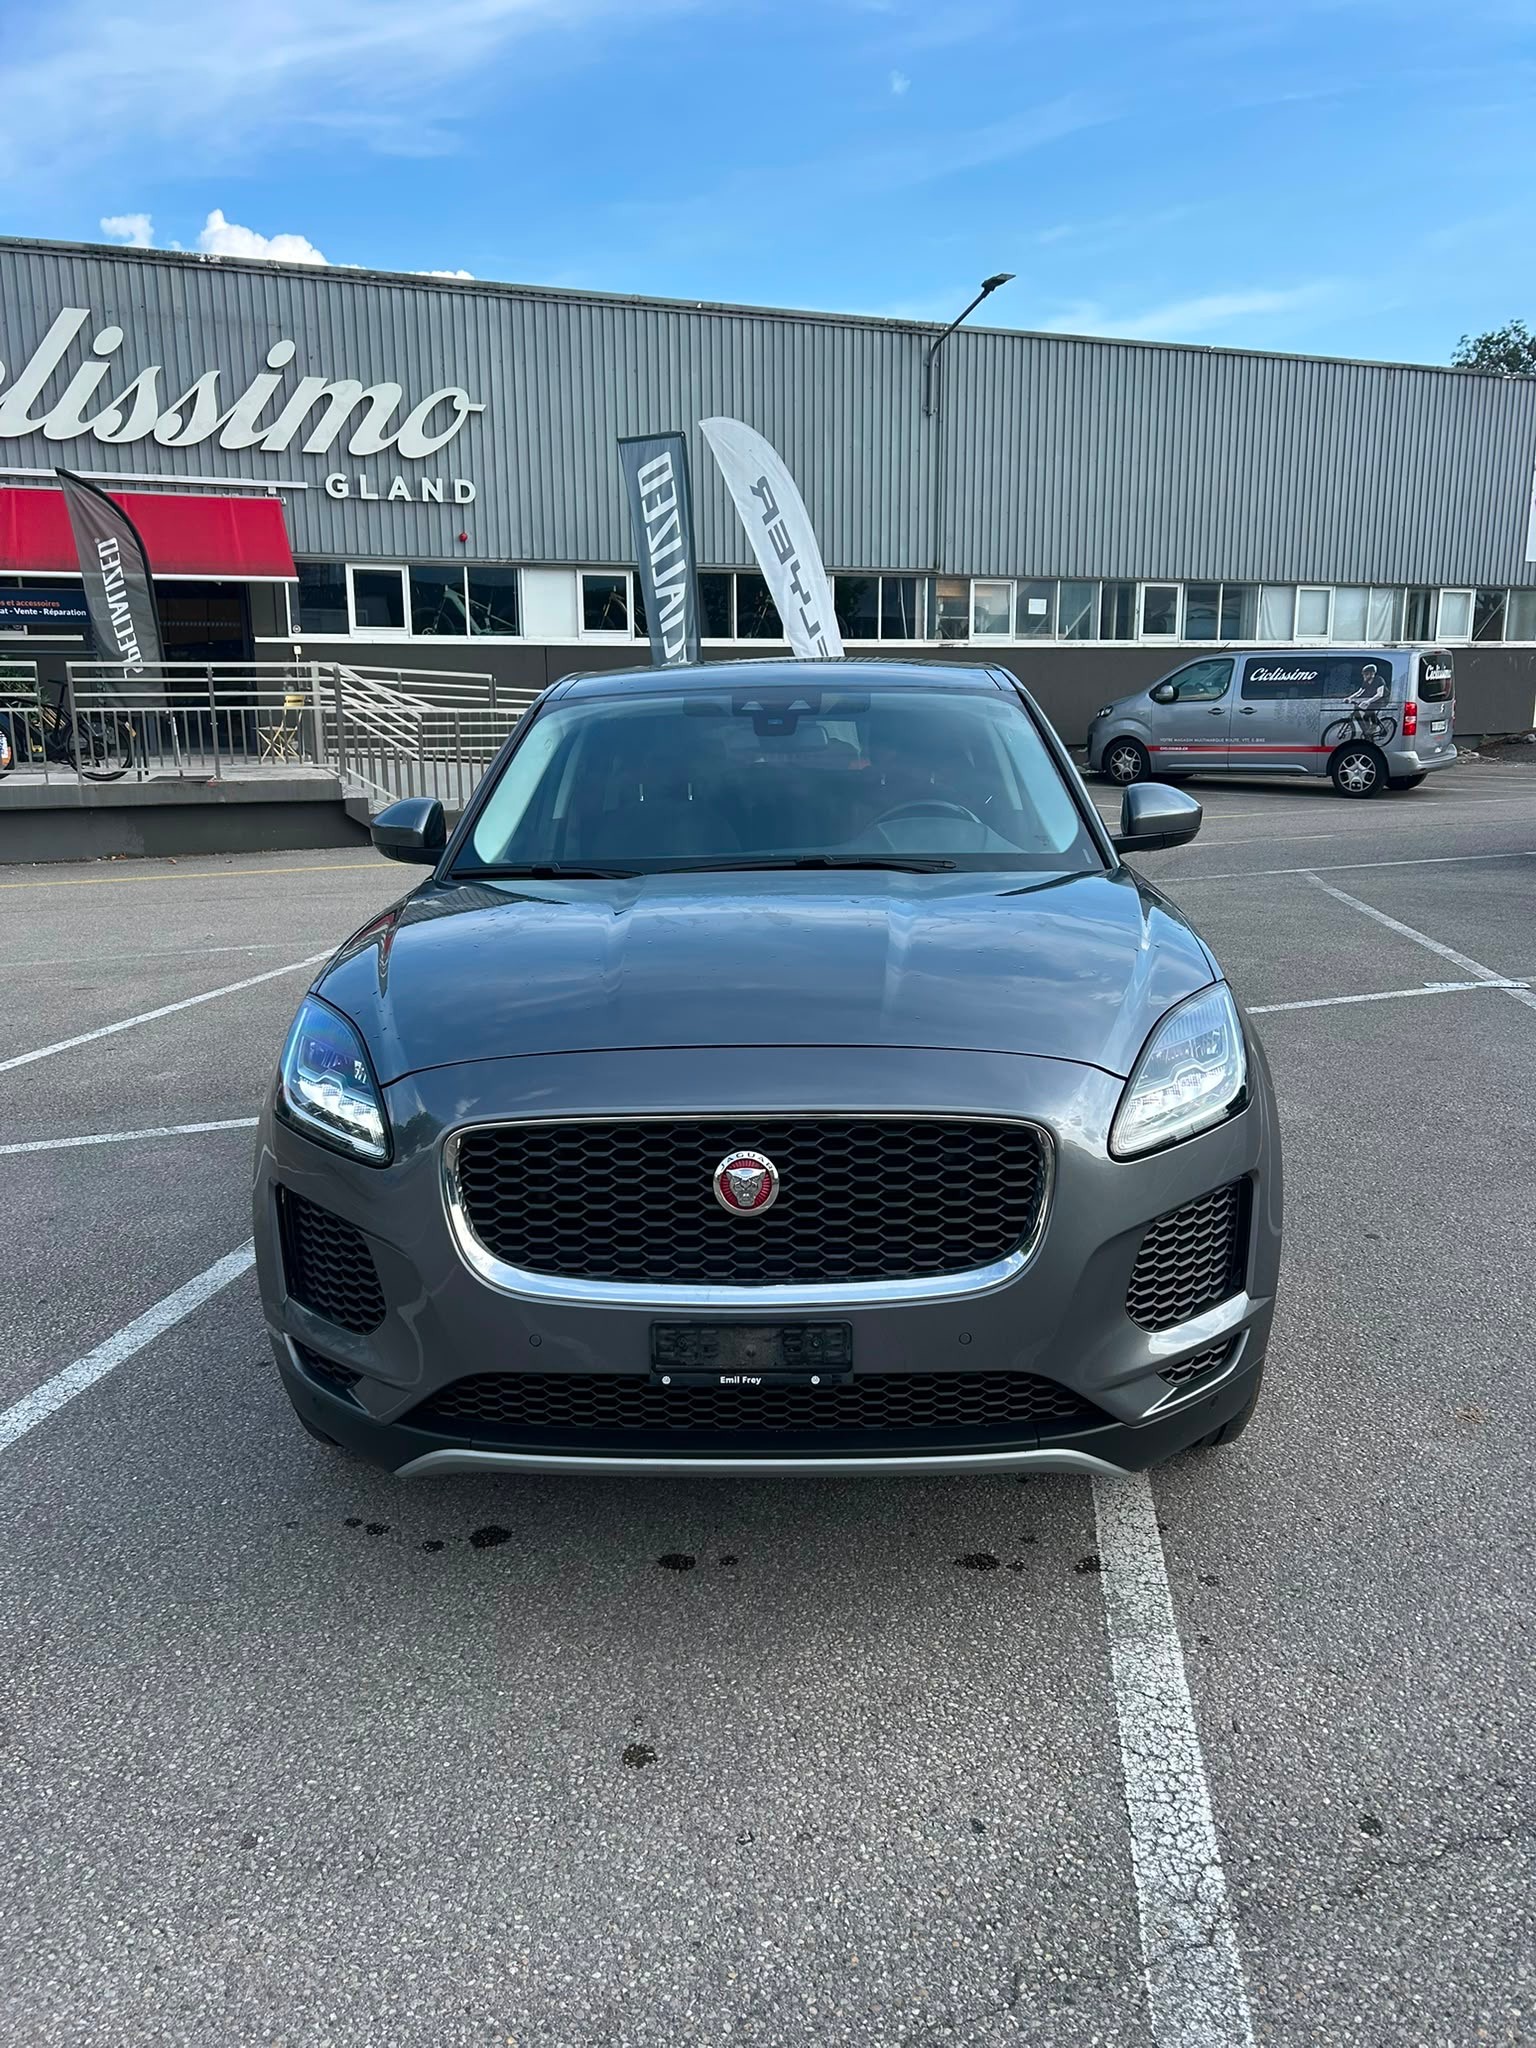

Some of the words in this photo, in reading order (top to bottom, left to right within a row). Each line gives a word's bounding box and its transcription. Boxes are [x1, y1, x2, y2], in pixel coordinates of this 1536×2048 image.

[0, 307, 486, 459] lissimo
[325, 472, 476, 504] GLAND
[14, 607, 38, 615] Vente
[43, 608, 87, 617] Réparation
[1250, 667, 1318, 681] Ciclissimo
[720, 1152, 773, 1171] JAGUAR
[720, 1375, 740, 1384] Emil
[742, 1375, 762, 1385] Frey
